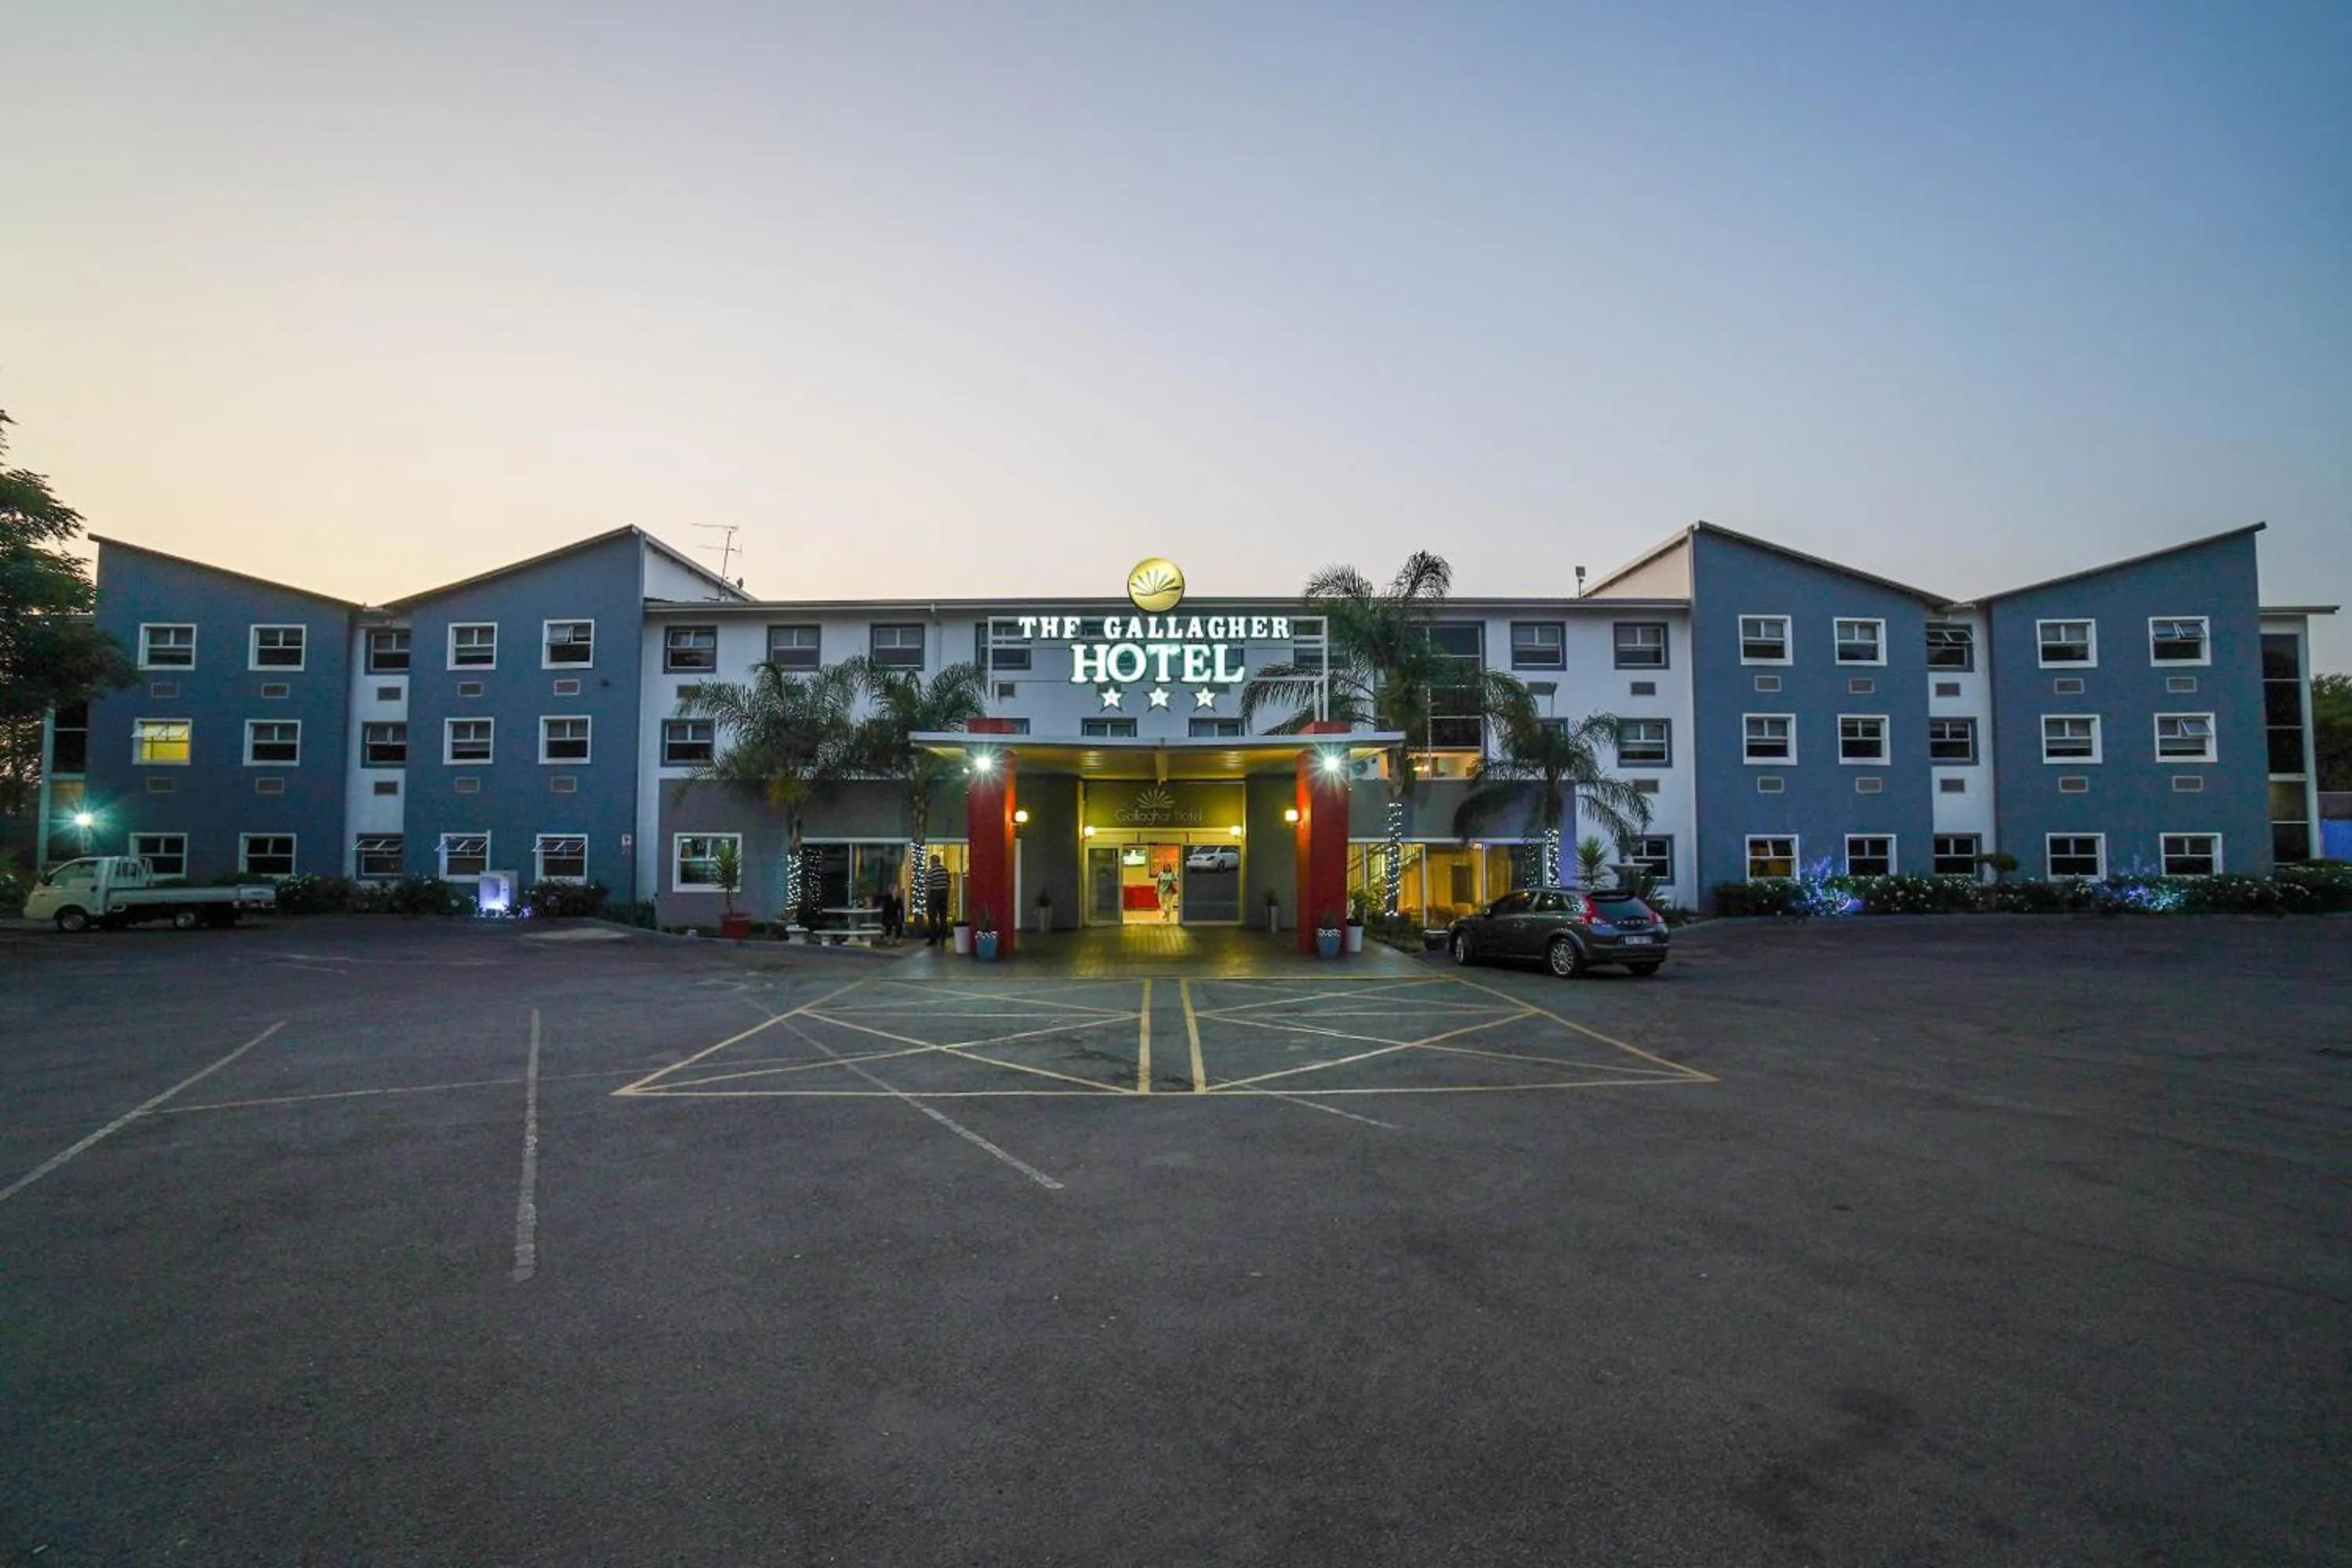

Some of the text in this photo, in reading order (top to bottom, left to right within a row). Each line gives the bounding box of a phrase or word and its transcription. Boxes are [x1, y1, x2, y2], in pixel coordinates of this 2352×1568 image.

[1019, 616, 1290, 639] THE GALLAGHER
[1070, 643, 1245, 683] HOTEL
